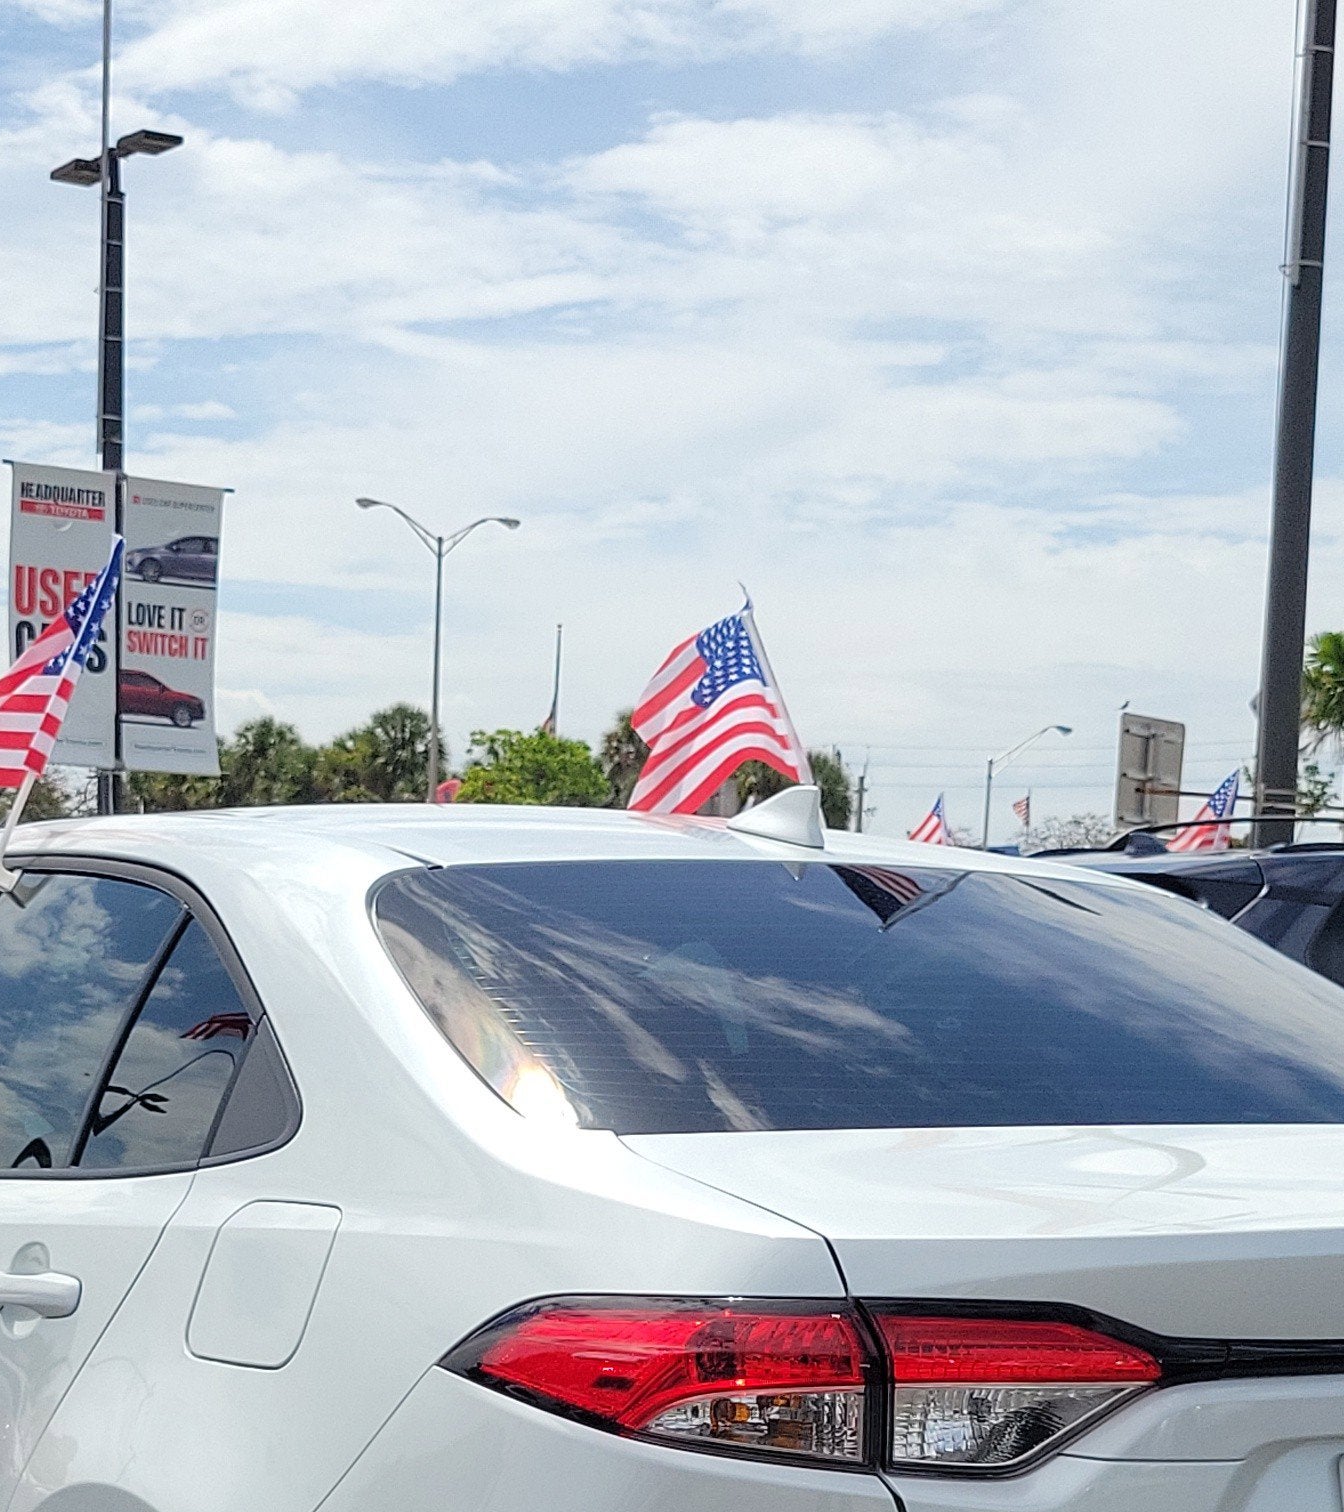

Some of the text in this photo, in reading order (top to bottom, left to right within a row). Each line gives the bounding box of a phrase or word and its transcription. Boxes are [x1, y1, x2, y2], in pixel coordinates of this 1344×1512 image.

[21, 481, 106, 507] HEADQUARTER
[16, 565, 99, 616] USE
[128, 601, 186, 629] LOVE IT
[16, 620, 107, 673] CS
[128, 630, 208, 660] SWITCH IT
